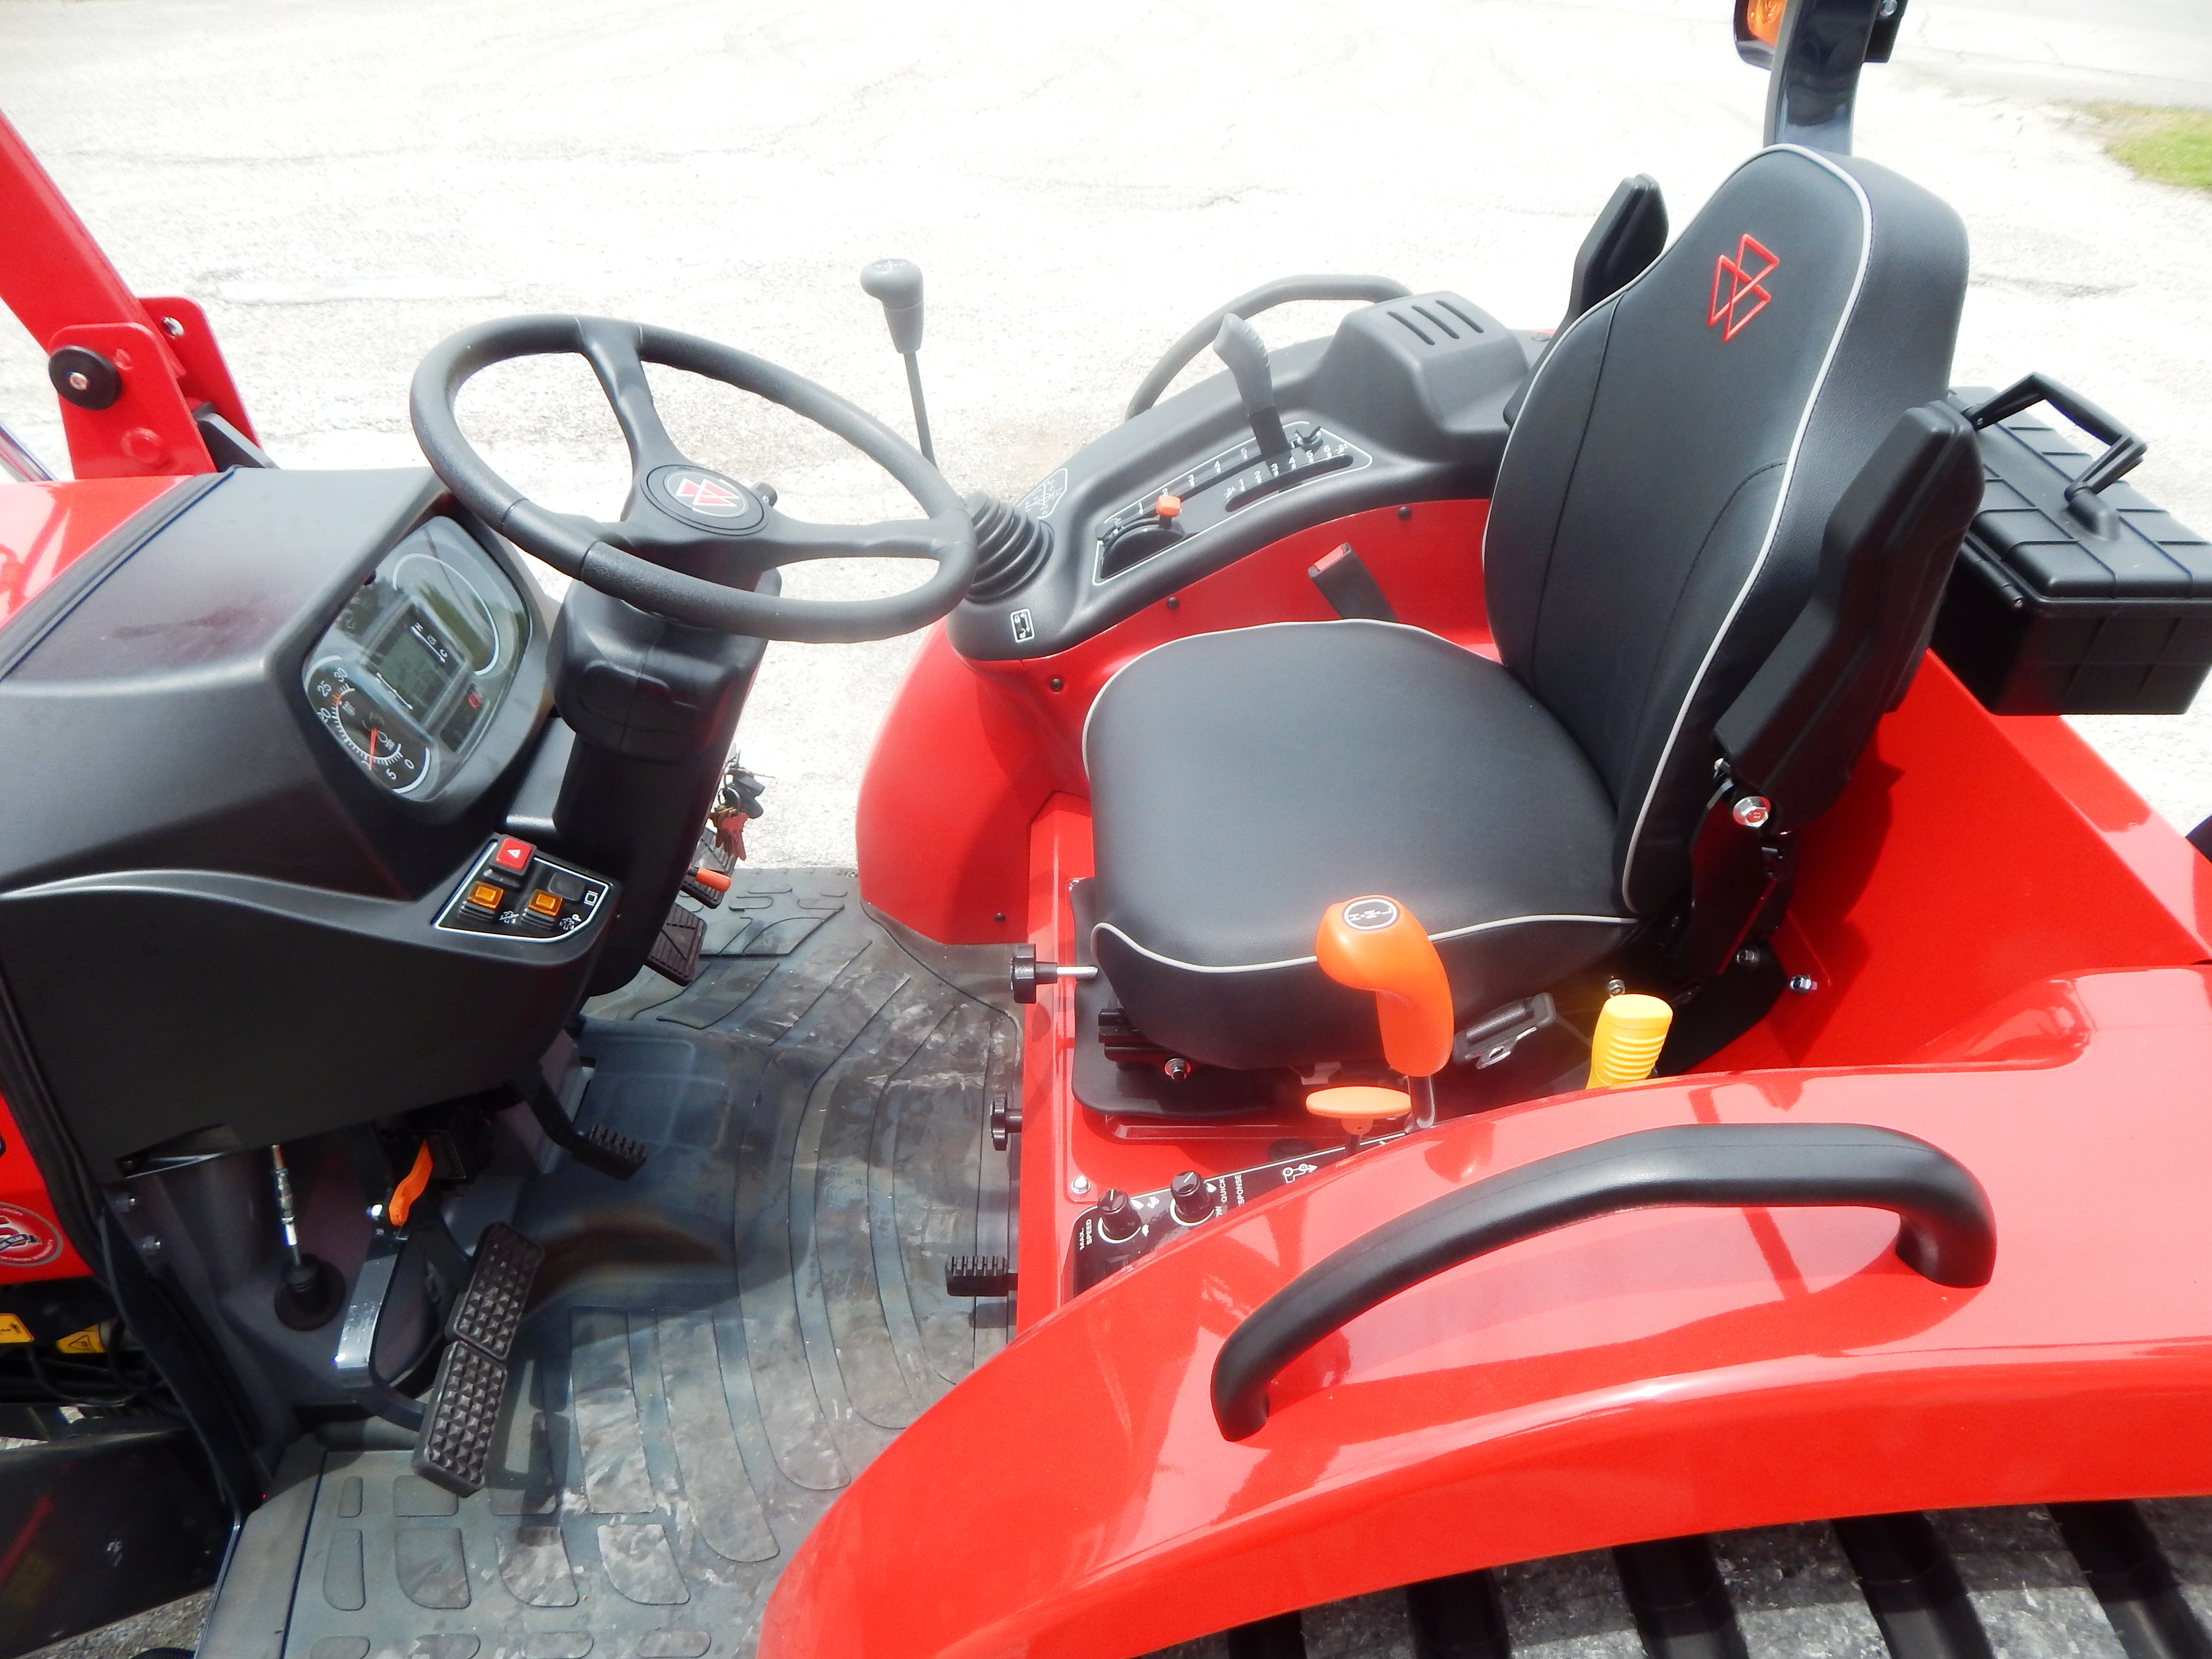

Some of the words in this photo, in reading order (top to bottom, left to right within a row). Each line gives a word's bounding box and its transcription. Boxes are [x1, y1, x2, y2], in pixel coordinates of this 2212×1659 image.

[1254, 470, 1261, 479] 2
[1271, 463, 1278, 471] 3
[1288, 456, 1296, 464] 4
[1306, 450, 1313, 458] 5
[334, 667, 348, 683] 30
[317, 680, 332, 697] 25
[317, 708, 331, 723] 20
[405, 759, 414, 769] 0
[386, 768, 397, 780] 5
[572, 914, 582, 922] P
[1219, 1178, 1227, 1202] QUICK
